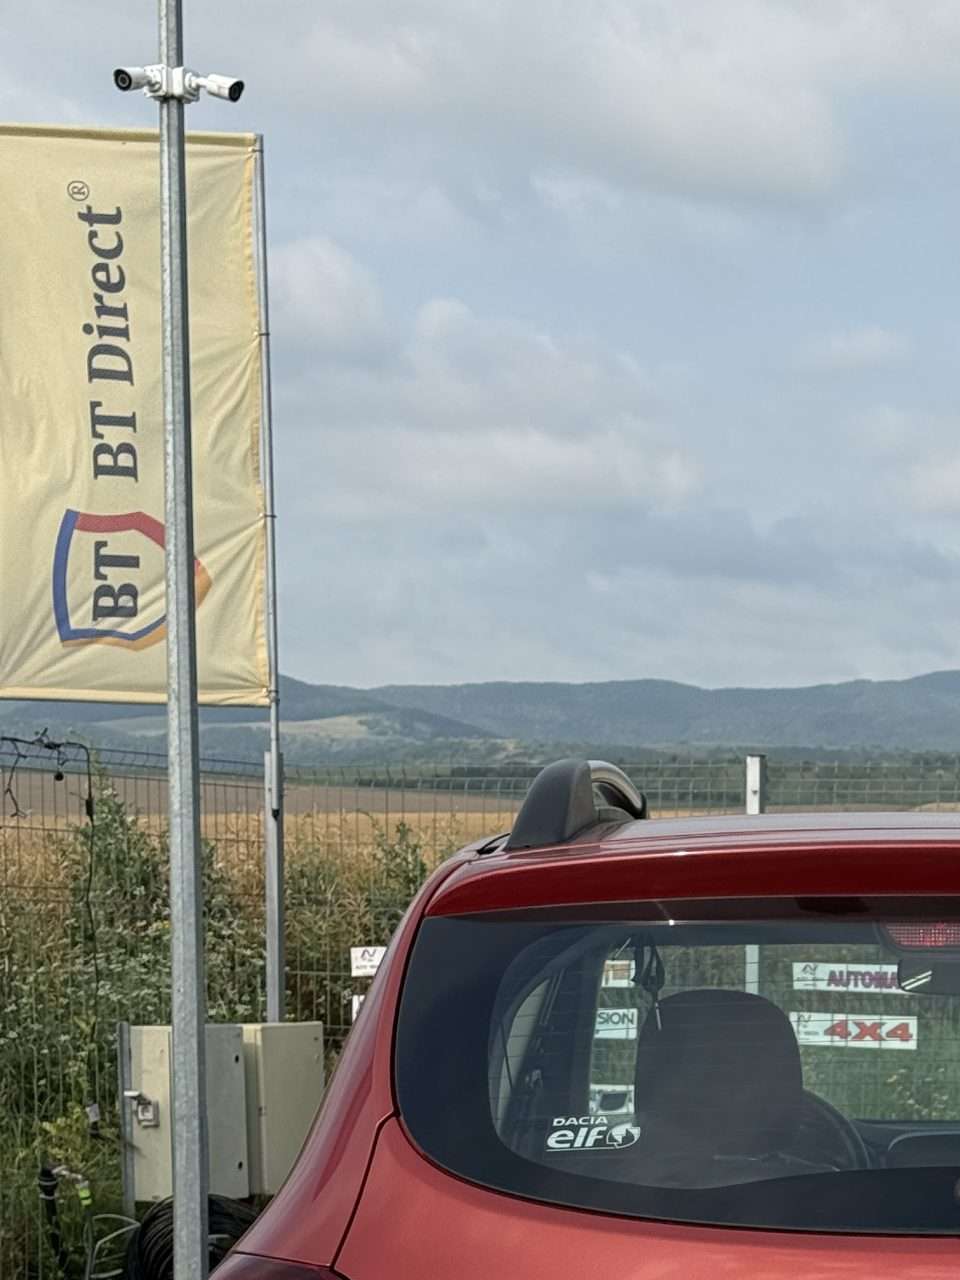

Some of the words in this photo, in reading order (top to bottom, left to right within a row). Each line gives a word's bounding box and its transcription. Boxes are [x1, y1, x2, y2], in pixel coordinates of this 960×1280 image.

[90, 400, 139, 482] BT
[91, 540, 140, 621] BT
[826, 970, 900, 990] AUTOMA
[598, 1012, 635, 1025] SION
[552, 1116, 608, 1127] DACIA
[547, 1126, 607, 1149] elf
